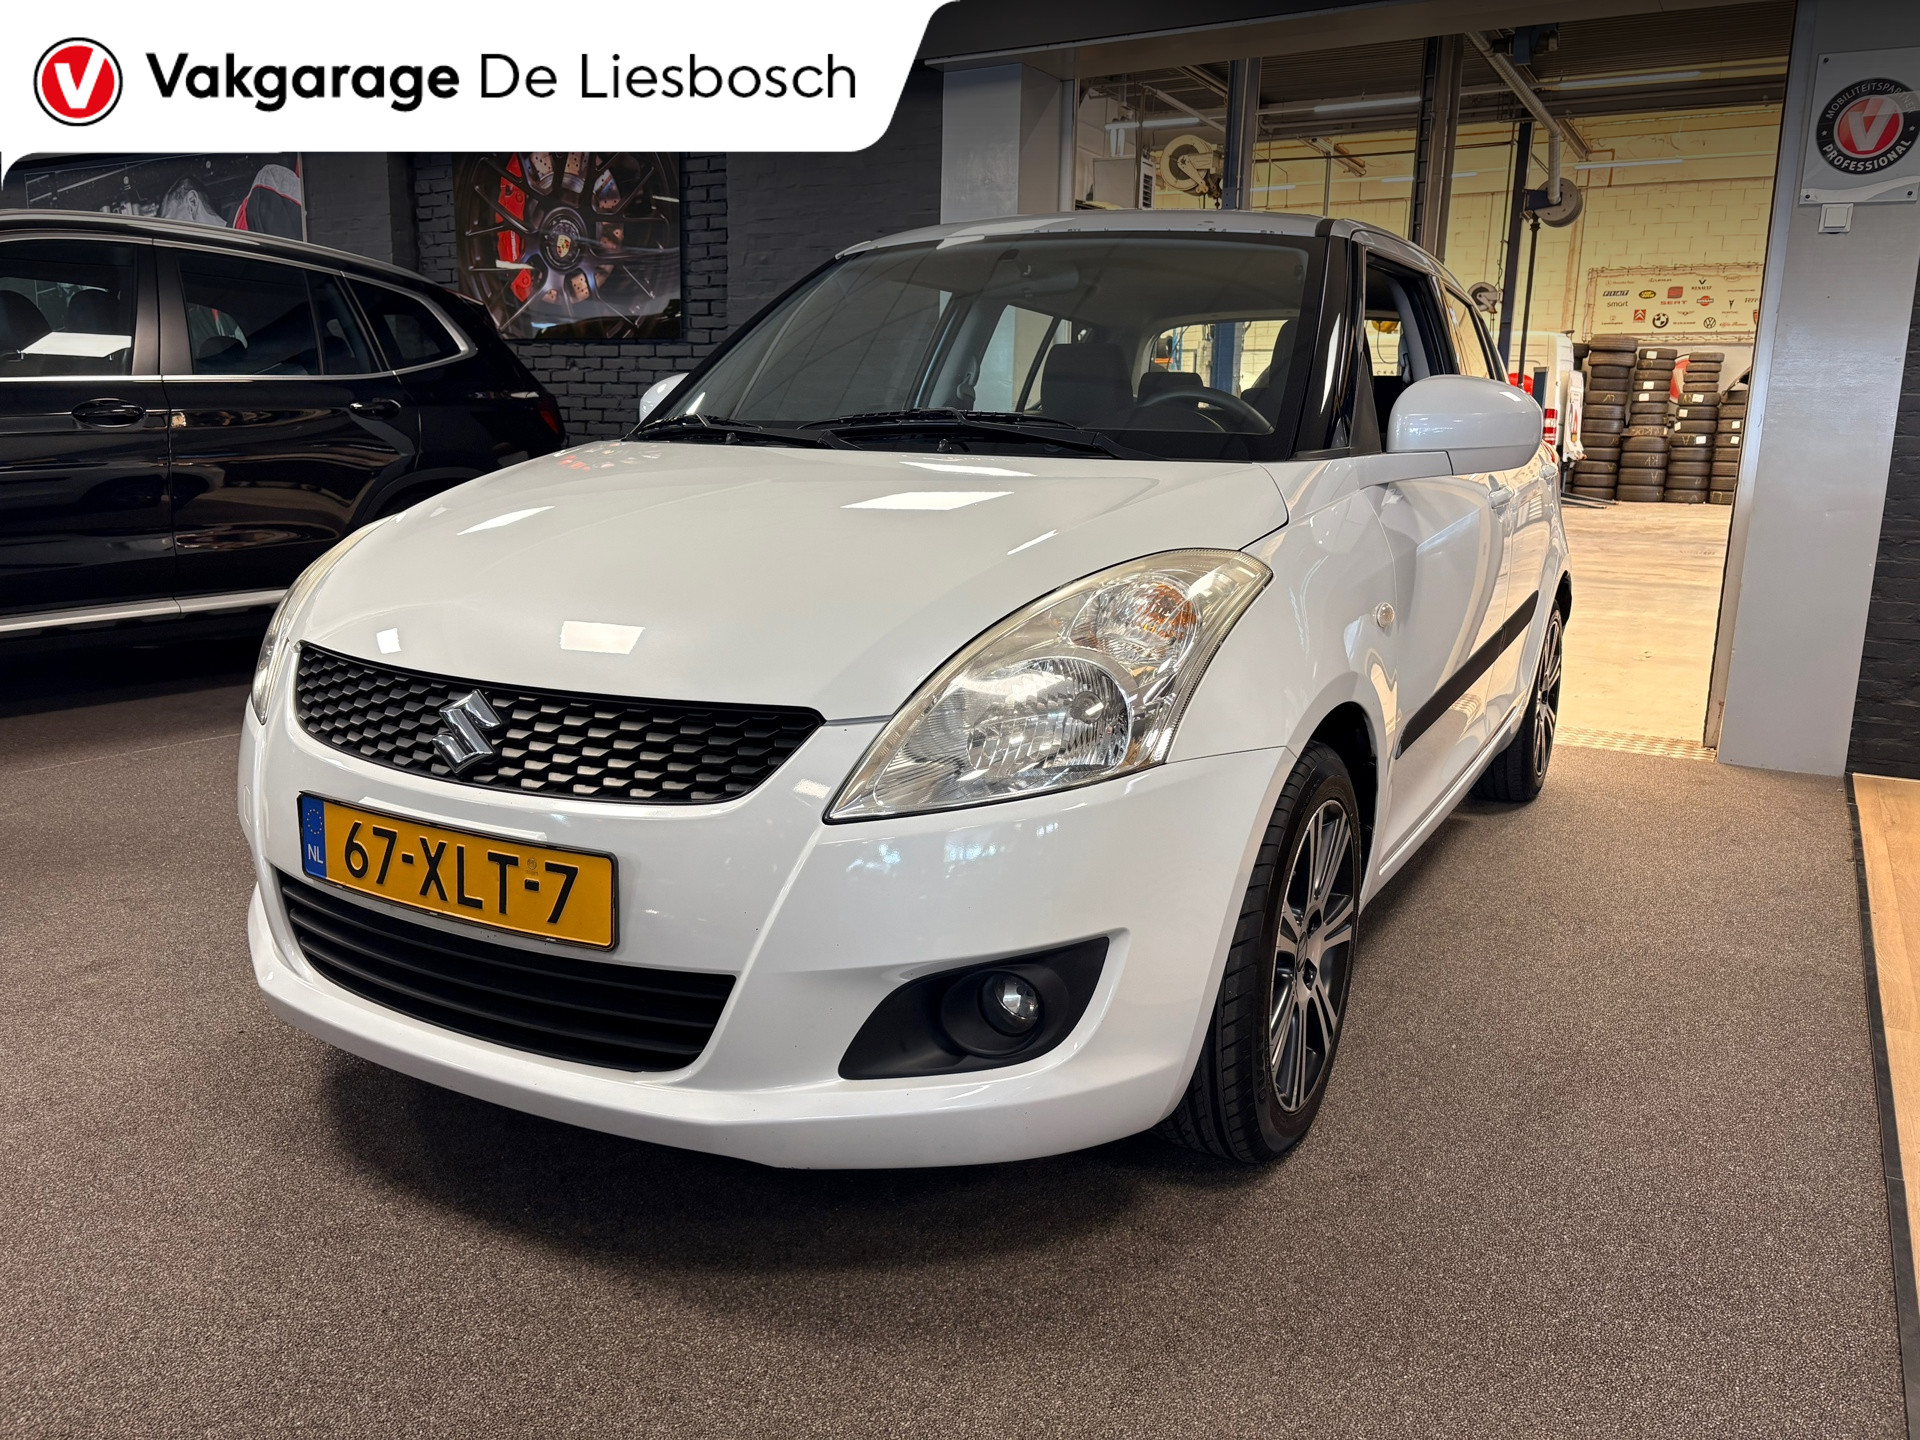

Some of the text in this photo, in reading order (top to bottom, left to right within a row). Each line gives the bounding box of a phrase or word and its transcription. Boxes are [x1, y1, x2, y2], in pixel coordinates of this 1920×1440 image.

[1822, 139, 1912, 172] PROFESSIONAL
[307, 843, 324, 865] NL
[344, 821, 579, 924] 67-XLT-7
